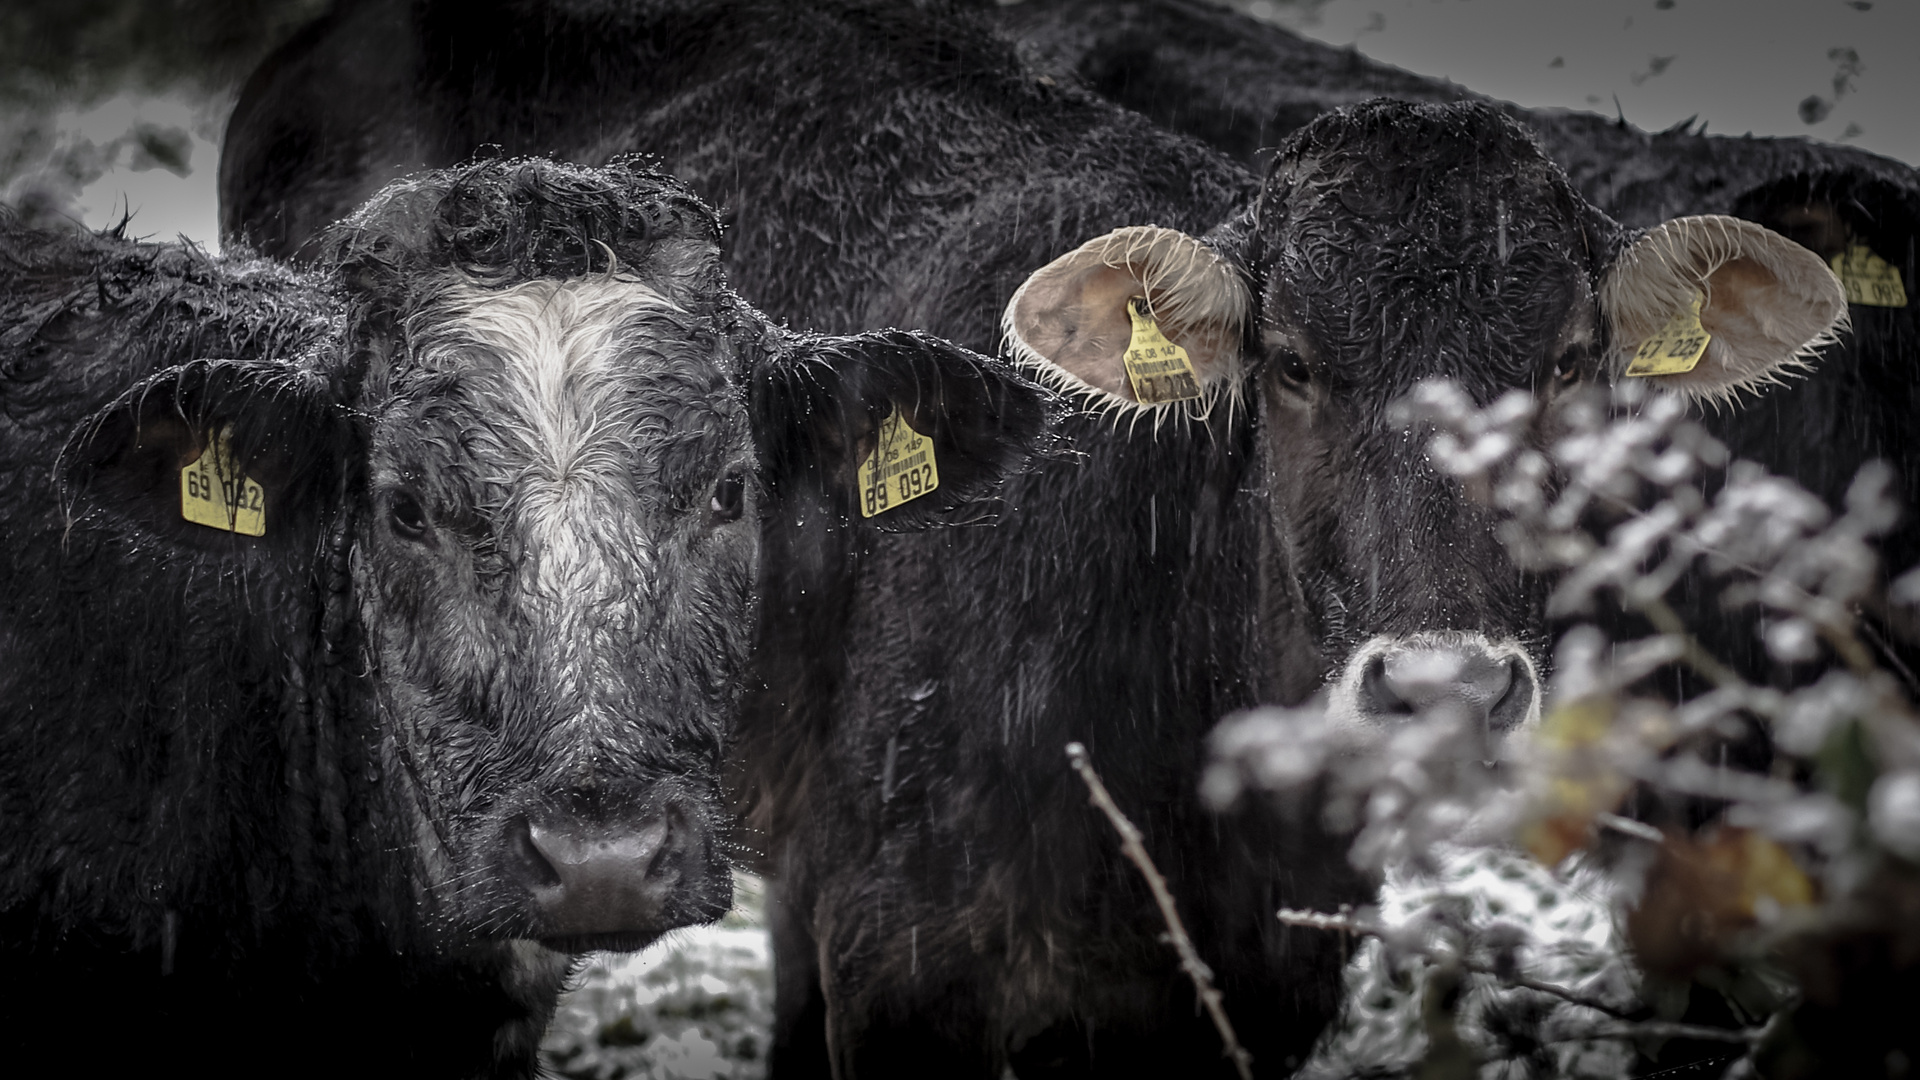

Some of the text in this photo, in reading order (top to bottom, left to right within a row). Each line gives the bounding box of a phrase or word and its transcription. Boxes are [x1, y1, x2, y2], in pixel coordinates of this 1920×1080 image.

[1130, 345, 1176, 361] DE 08 147
[1639, 337, 1705, 359] 47 225
[188, 470, 211, 502] 69
[899, 463, 935, 500] 092
